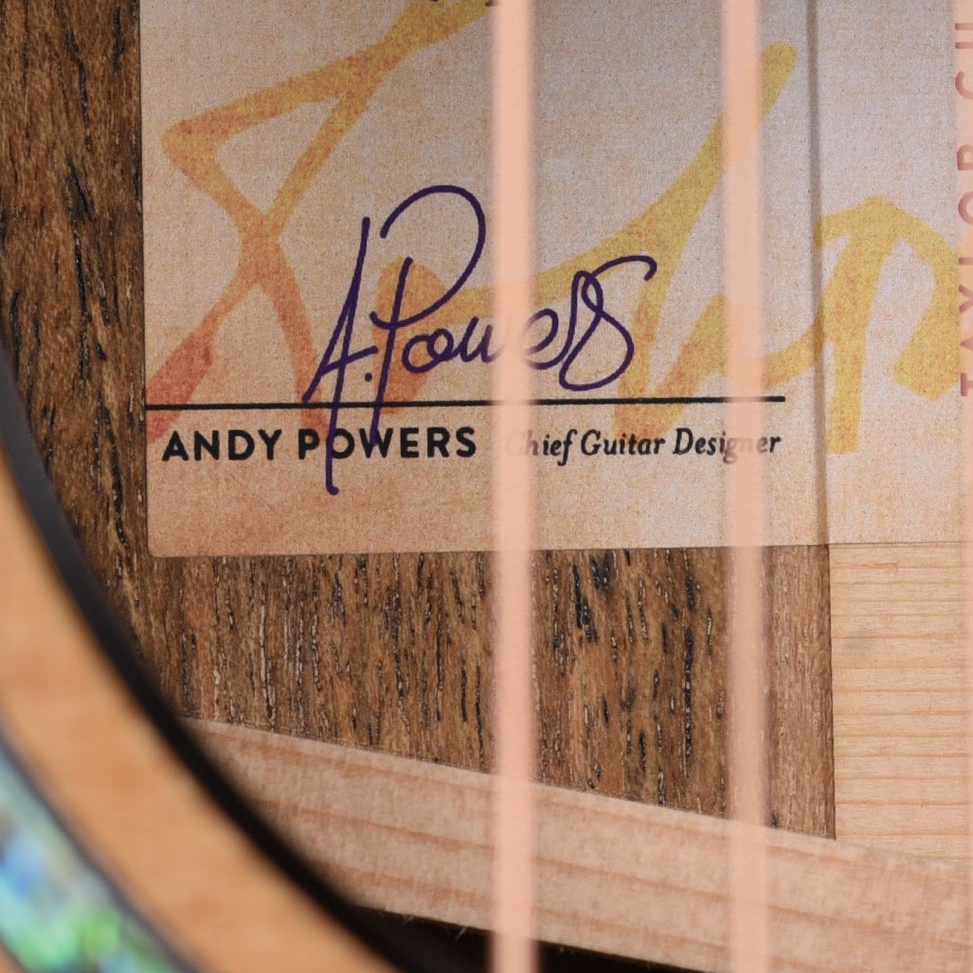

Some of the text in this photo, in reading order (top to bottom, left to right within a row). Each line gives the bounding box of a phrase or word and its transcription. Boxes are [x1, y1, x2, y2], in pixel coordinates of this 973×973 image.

[161, 429, 283, 462] ANDY
[297, 427, 477, 461] POWERS
[505, 428, 578, 467] hief
[580, 428, 667, 457] Guitar
